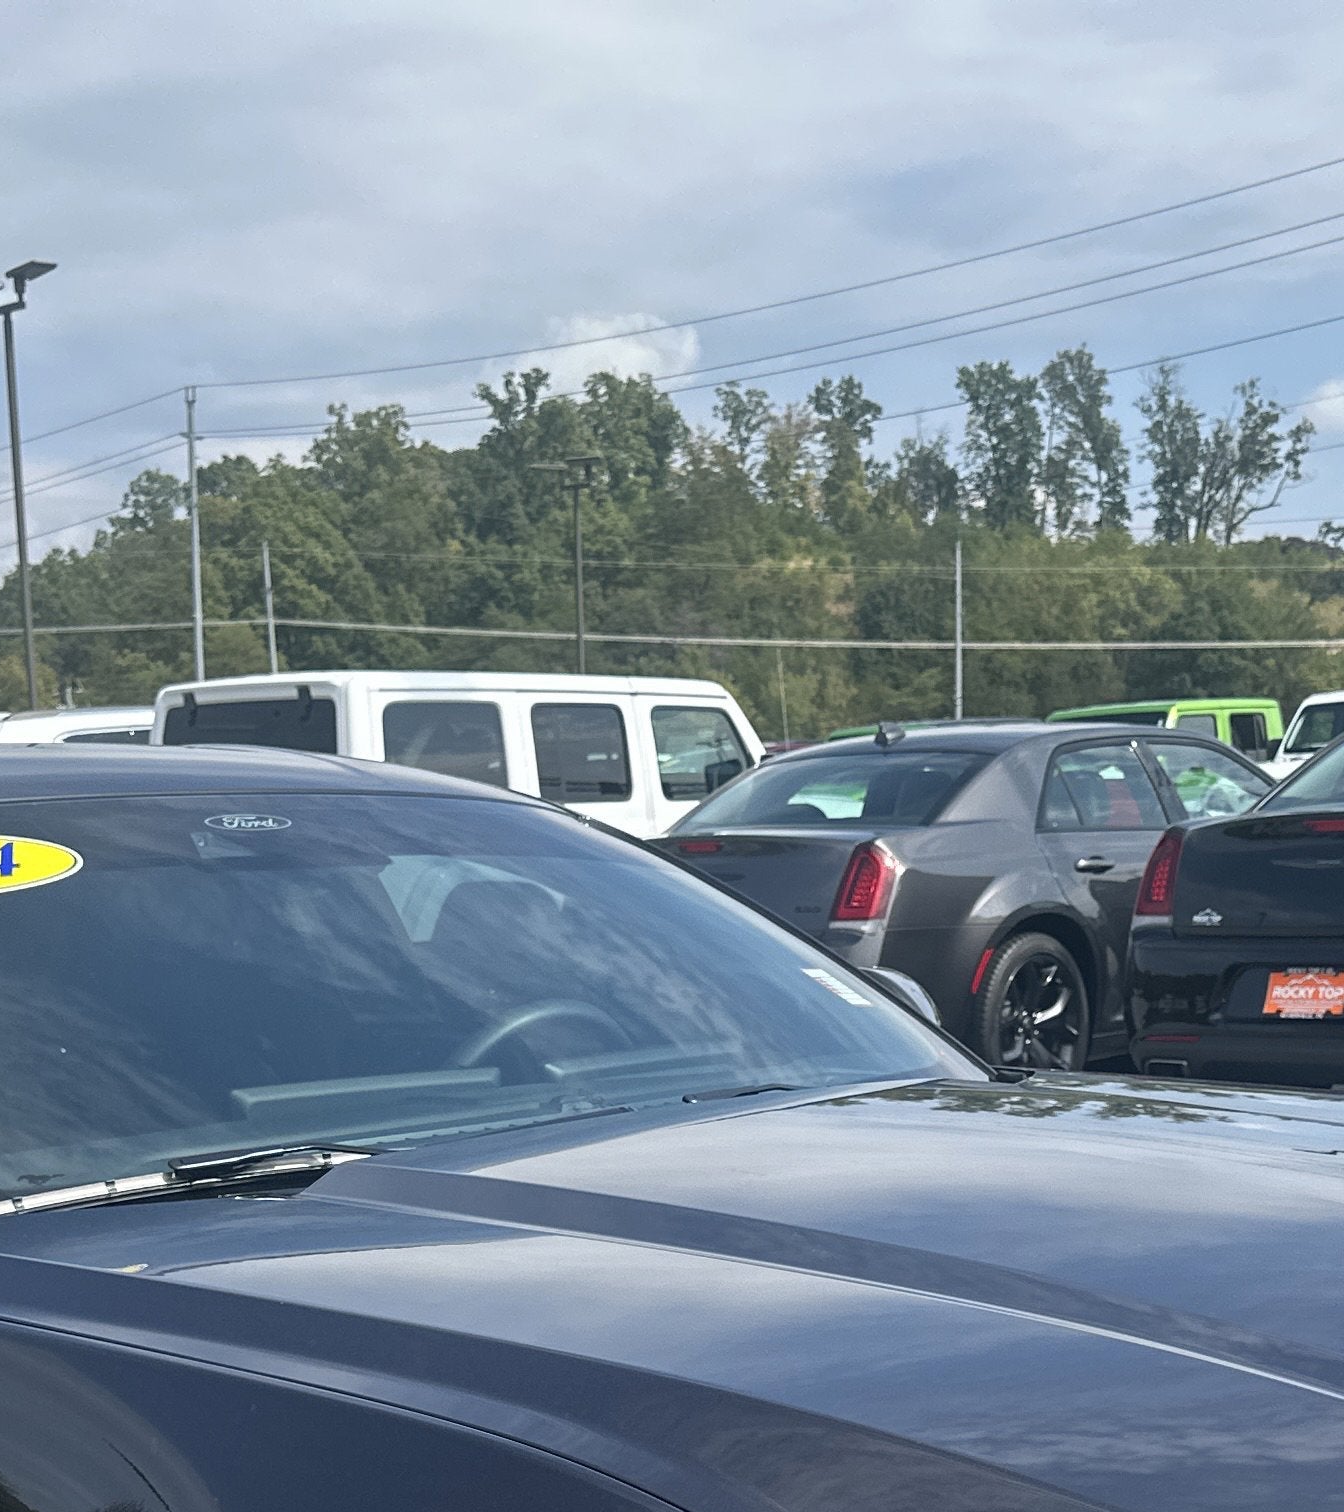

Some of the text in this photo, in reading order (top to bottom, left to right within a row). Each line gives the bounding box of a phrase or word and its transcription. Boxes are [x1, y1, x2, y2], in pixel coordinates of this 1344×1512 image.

[222, 816, 278, 829] Ford
[1272, 985, 1344, 1000] ROCKY TOP
